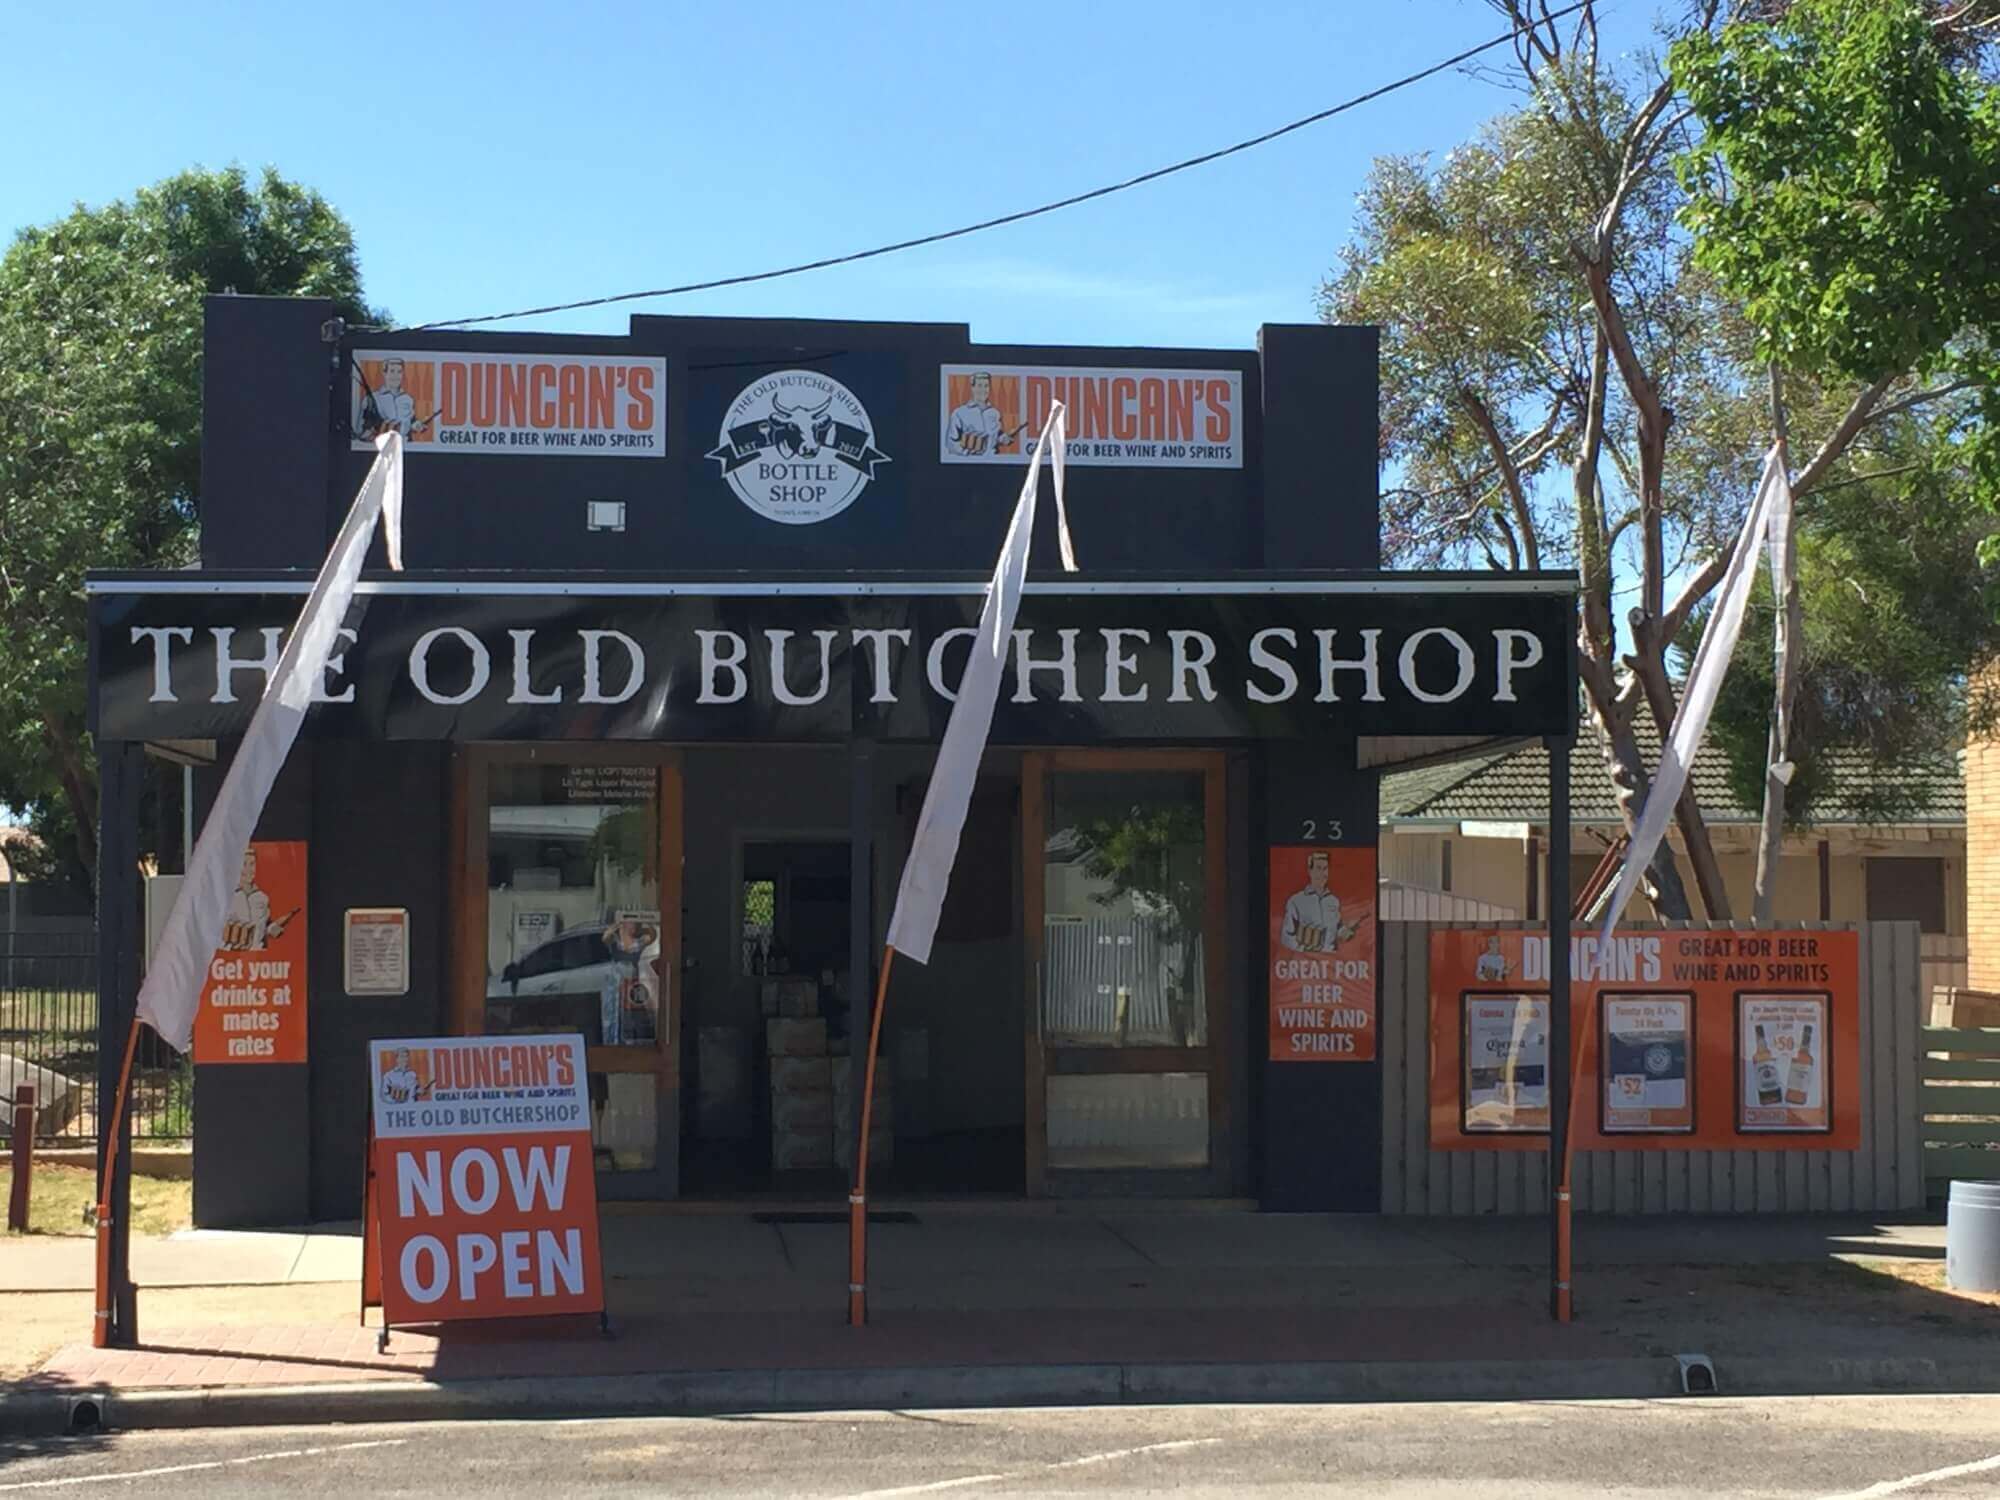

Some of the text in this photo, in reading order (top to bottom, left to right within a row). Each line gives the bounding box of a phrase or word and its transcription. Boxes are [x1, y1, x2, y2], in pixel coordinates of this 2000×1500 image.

[441, 362, 654, 431] DUNCAN'S
[733, 375, 863, 417] THE OLD BUTCHER SHOP
[1026, 376, 1231, 442] DUNCAN'S
[439, 430, 654, 449] GREAT FOR BEER WINE AND SPIRITS
[1067, 443, 1089, 457] FOR
[1092, 444, 1121, 457] BEER
[1125, 444, 1157, 458] WINE
[1160, 445, 1186, 458] AND
[1189, 445, 1232, 460] SPIRITS
[759, 463, 838, 480] BOTTLE
[769, 485, 827, 503] SHOP
[130, 627, 357, 703] THE
[408, 627, 646, 704] OLD
[1678, 938, 1818, 957] GREAT FOR BEER
[211, 958, 290, 981] Get your
[1275, 960, 1368, 980] GREAT FOR
[1673, 963, 1829, 982] WINE AND SPIRITS
[211, 985, 291, 1006] drinks at
[1302, 985, 1343, 1004] BEER
[223, 1011, 280, 1031] mates
[1278, 1008, 1368, 1028] WINE AND
[228, 1035, 275, 1057] rates
[1291, 1033, 1355, 1053] SPIRITS
[432, 1044, 575, 1089] DUNCAN'S
[386, 1104, 580, 1128] THE OLD BUTCHERSHOP
[396, 1145, 572, 1218] NOW
[400, 1228, 585, 1304] OPEN
